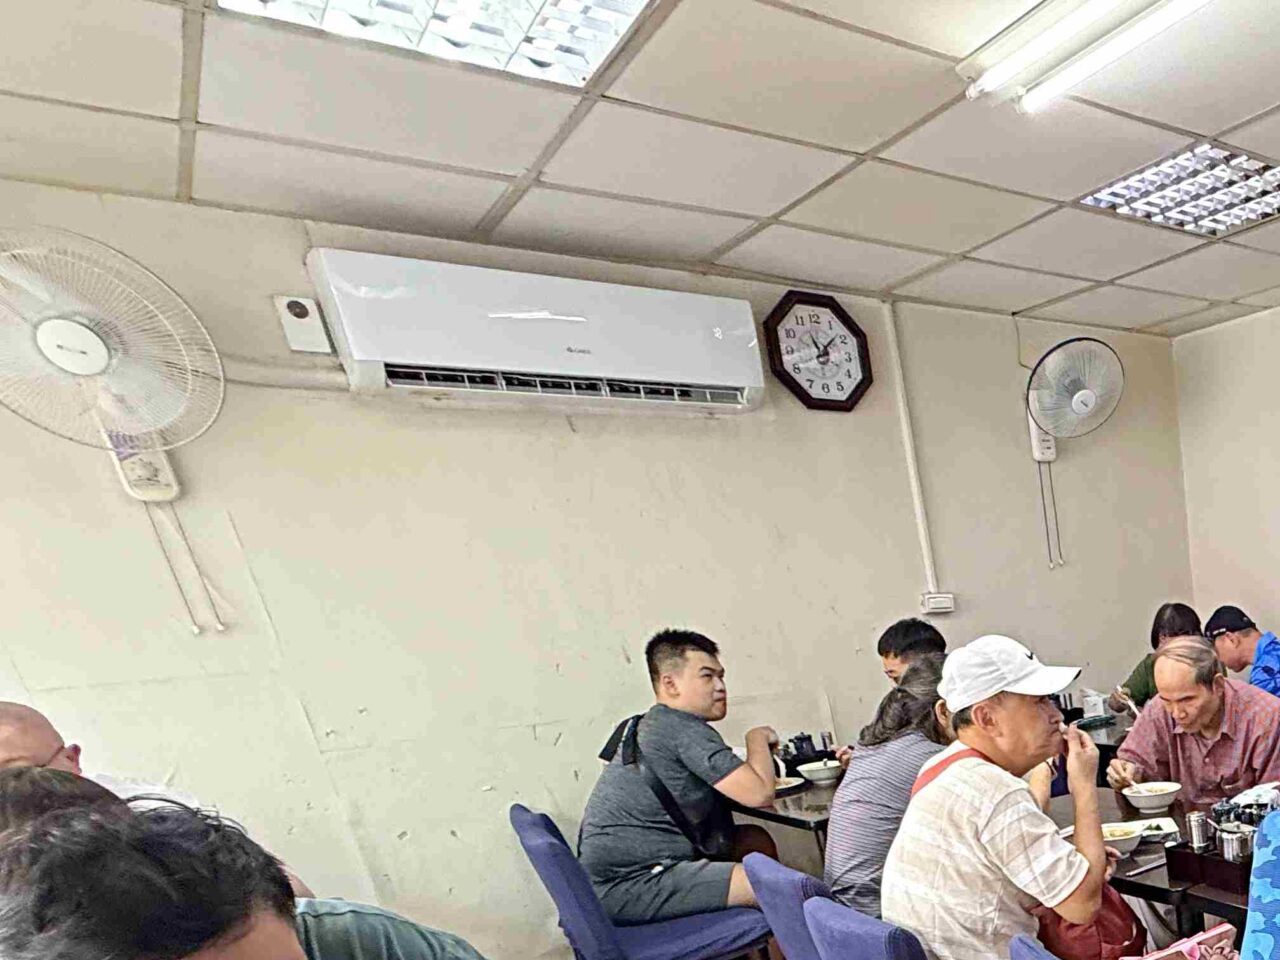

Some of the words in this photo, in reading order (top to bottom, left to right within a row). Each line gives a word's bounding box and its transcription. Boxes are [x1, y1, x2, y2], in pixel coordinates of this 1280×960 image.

[795, 315, 805, 326] 11
[808, 313, 821, 325] 12
[827, 320, 833, 330] 1
[785, 328, 795, 339] 10
[839, 335, 848, 345] 2
[785, 345, 794, 355] 9
[844, 352, 852, 363] 3
[793, 364, 801, 374] 8
[845, 369, 852, 379] 4
[805, 379, 814, 389] 7
[822, 383, 830, 393] 6
[836, 381, 844, 391] 5
